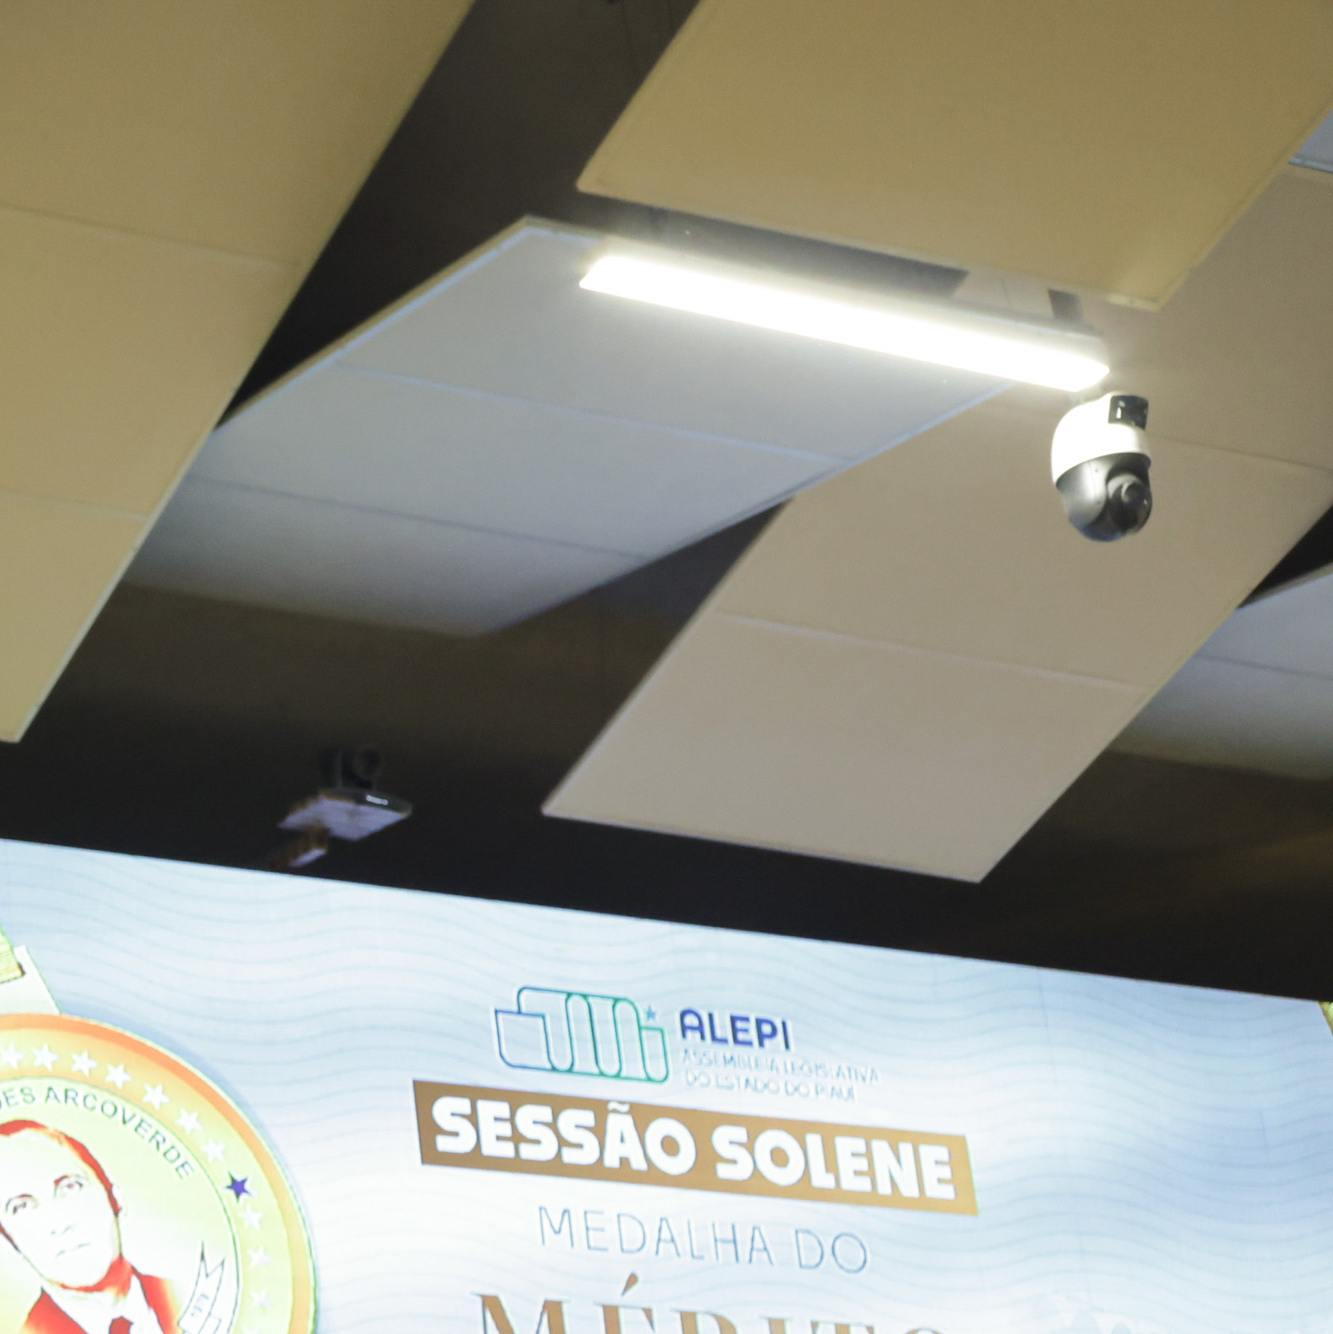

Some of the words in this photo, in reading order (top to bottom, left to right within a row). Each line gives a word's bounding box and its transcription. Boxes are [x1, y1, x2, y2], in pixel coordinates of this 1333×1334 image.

[679, 1008, 791, 1050] ALEPI
[45, 1086, 194, 1179] ARCOVERDE
[432, 1096, 695, 1175] SESSÃO
[715, 1125, 957, 1201] SOLENE
[537, 1205, 774, 1266] MEDALHA
[795, 1229, 870, 1274] DO
